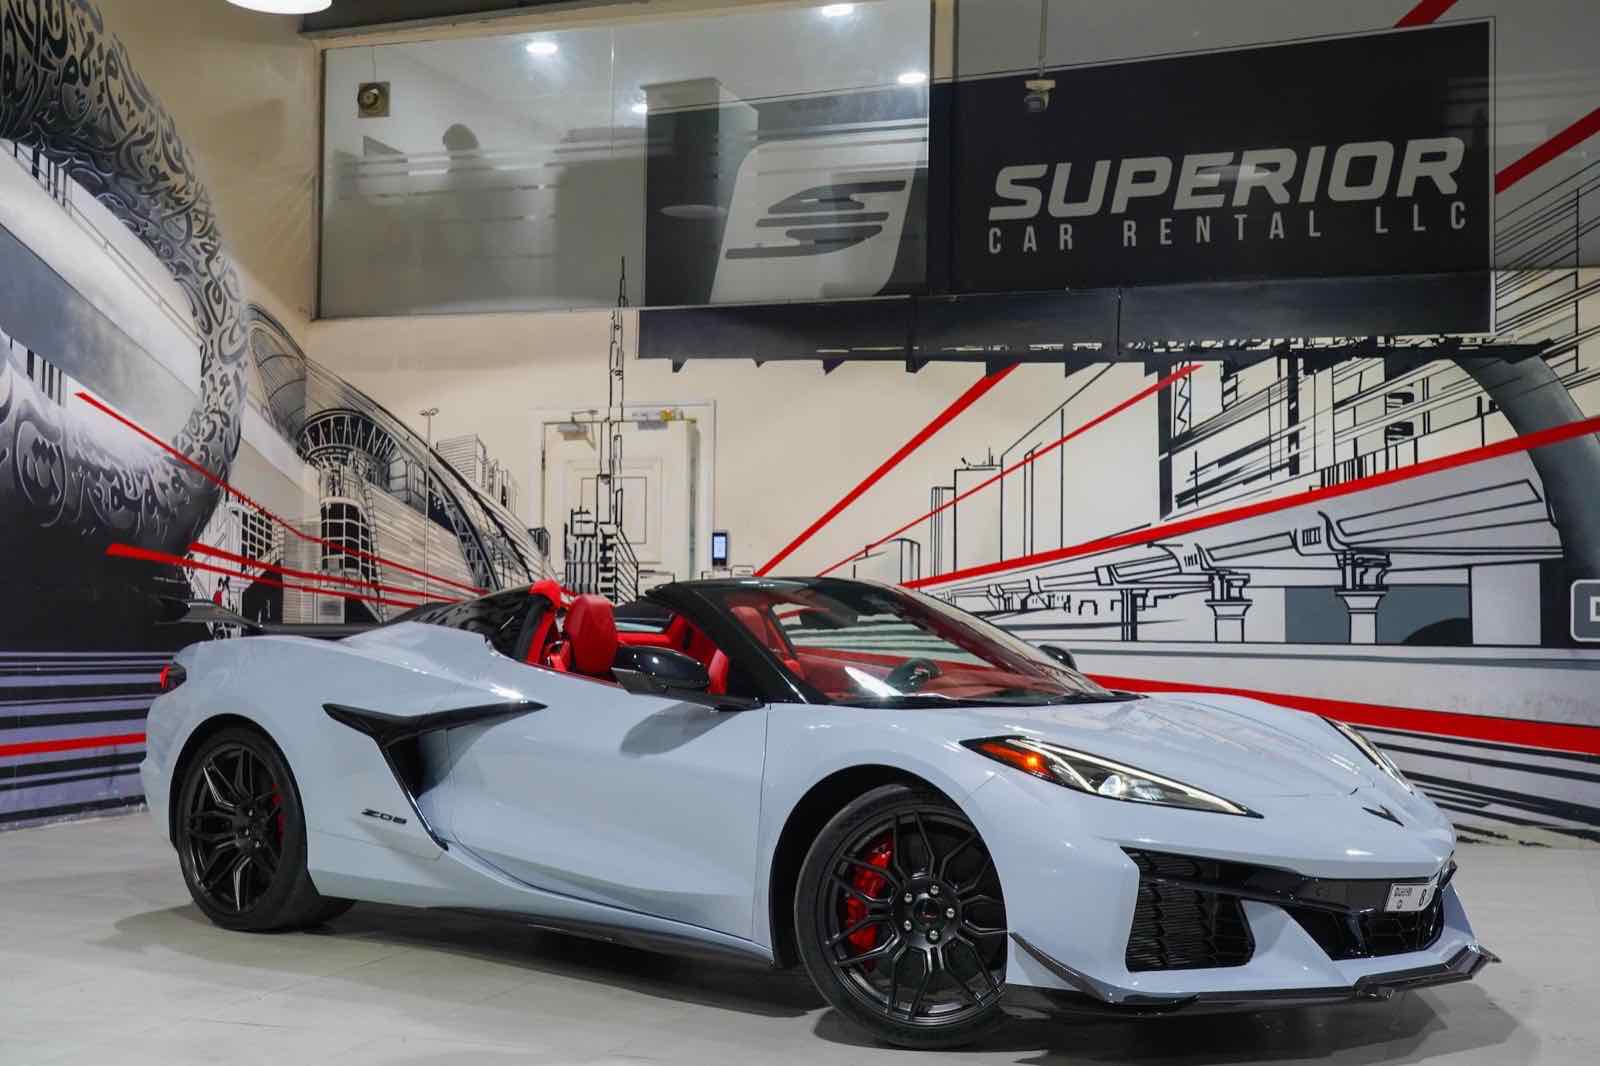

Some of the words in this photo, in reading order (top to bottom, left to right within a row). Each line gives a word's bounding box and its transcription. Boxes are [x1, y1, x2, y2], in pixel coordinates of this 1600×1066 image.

[988, 136, 1465, 221] SUPERIOR
[989, 226, 1073, 254] CAR
[1123, 206, 1321, 247] RENTAL
[1376, 201, 1466, 233] LLC
